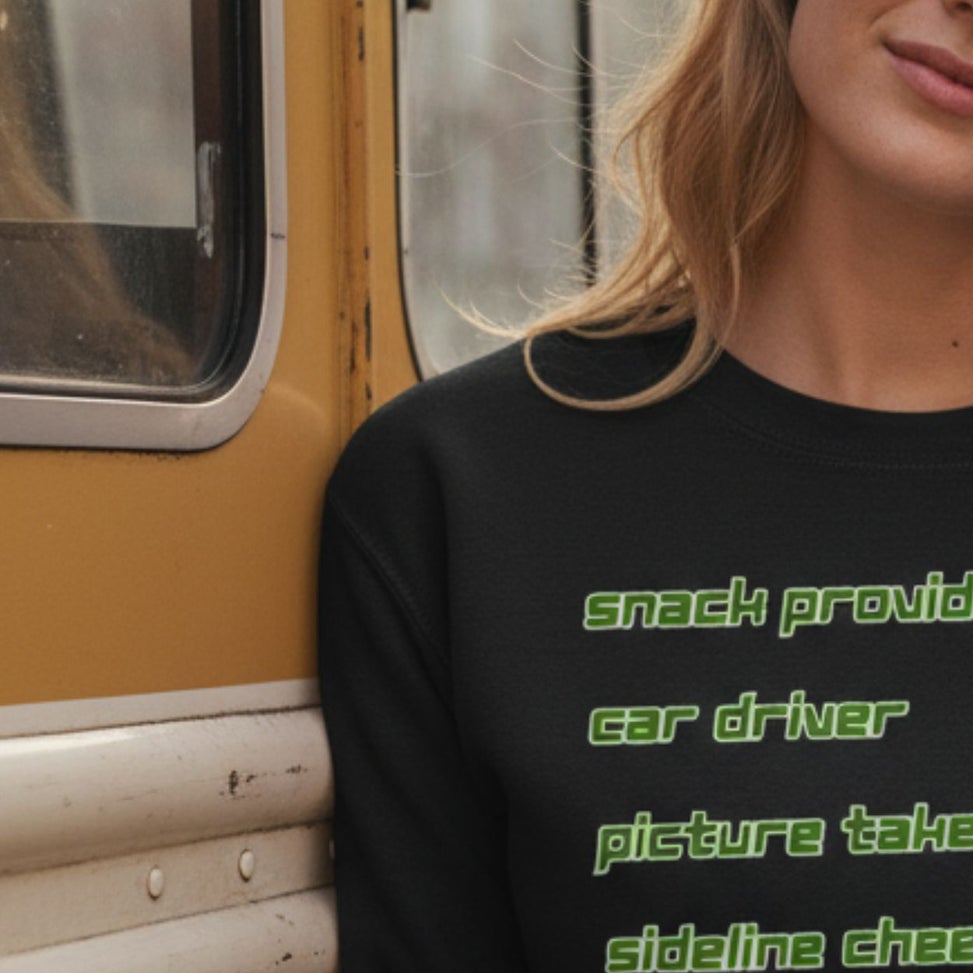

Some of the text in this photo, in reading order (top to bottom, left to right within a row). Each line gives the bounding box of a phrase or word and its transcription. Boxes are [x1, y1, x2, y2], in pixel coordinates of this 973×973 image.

[582, 576, 769, 631] snack
[587, 689, 910, 746] car driver
[593, 810, 827, 876] picture
